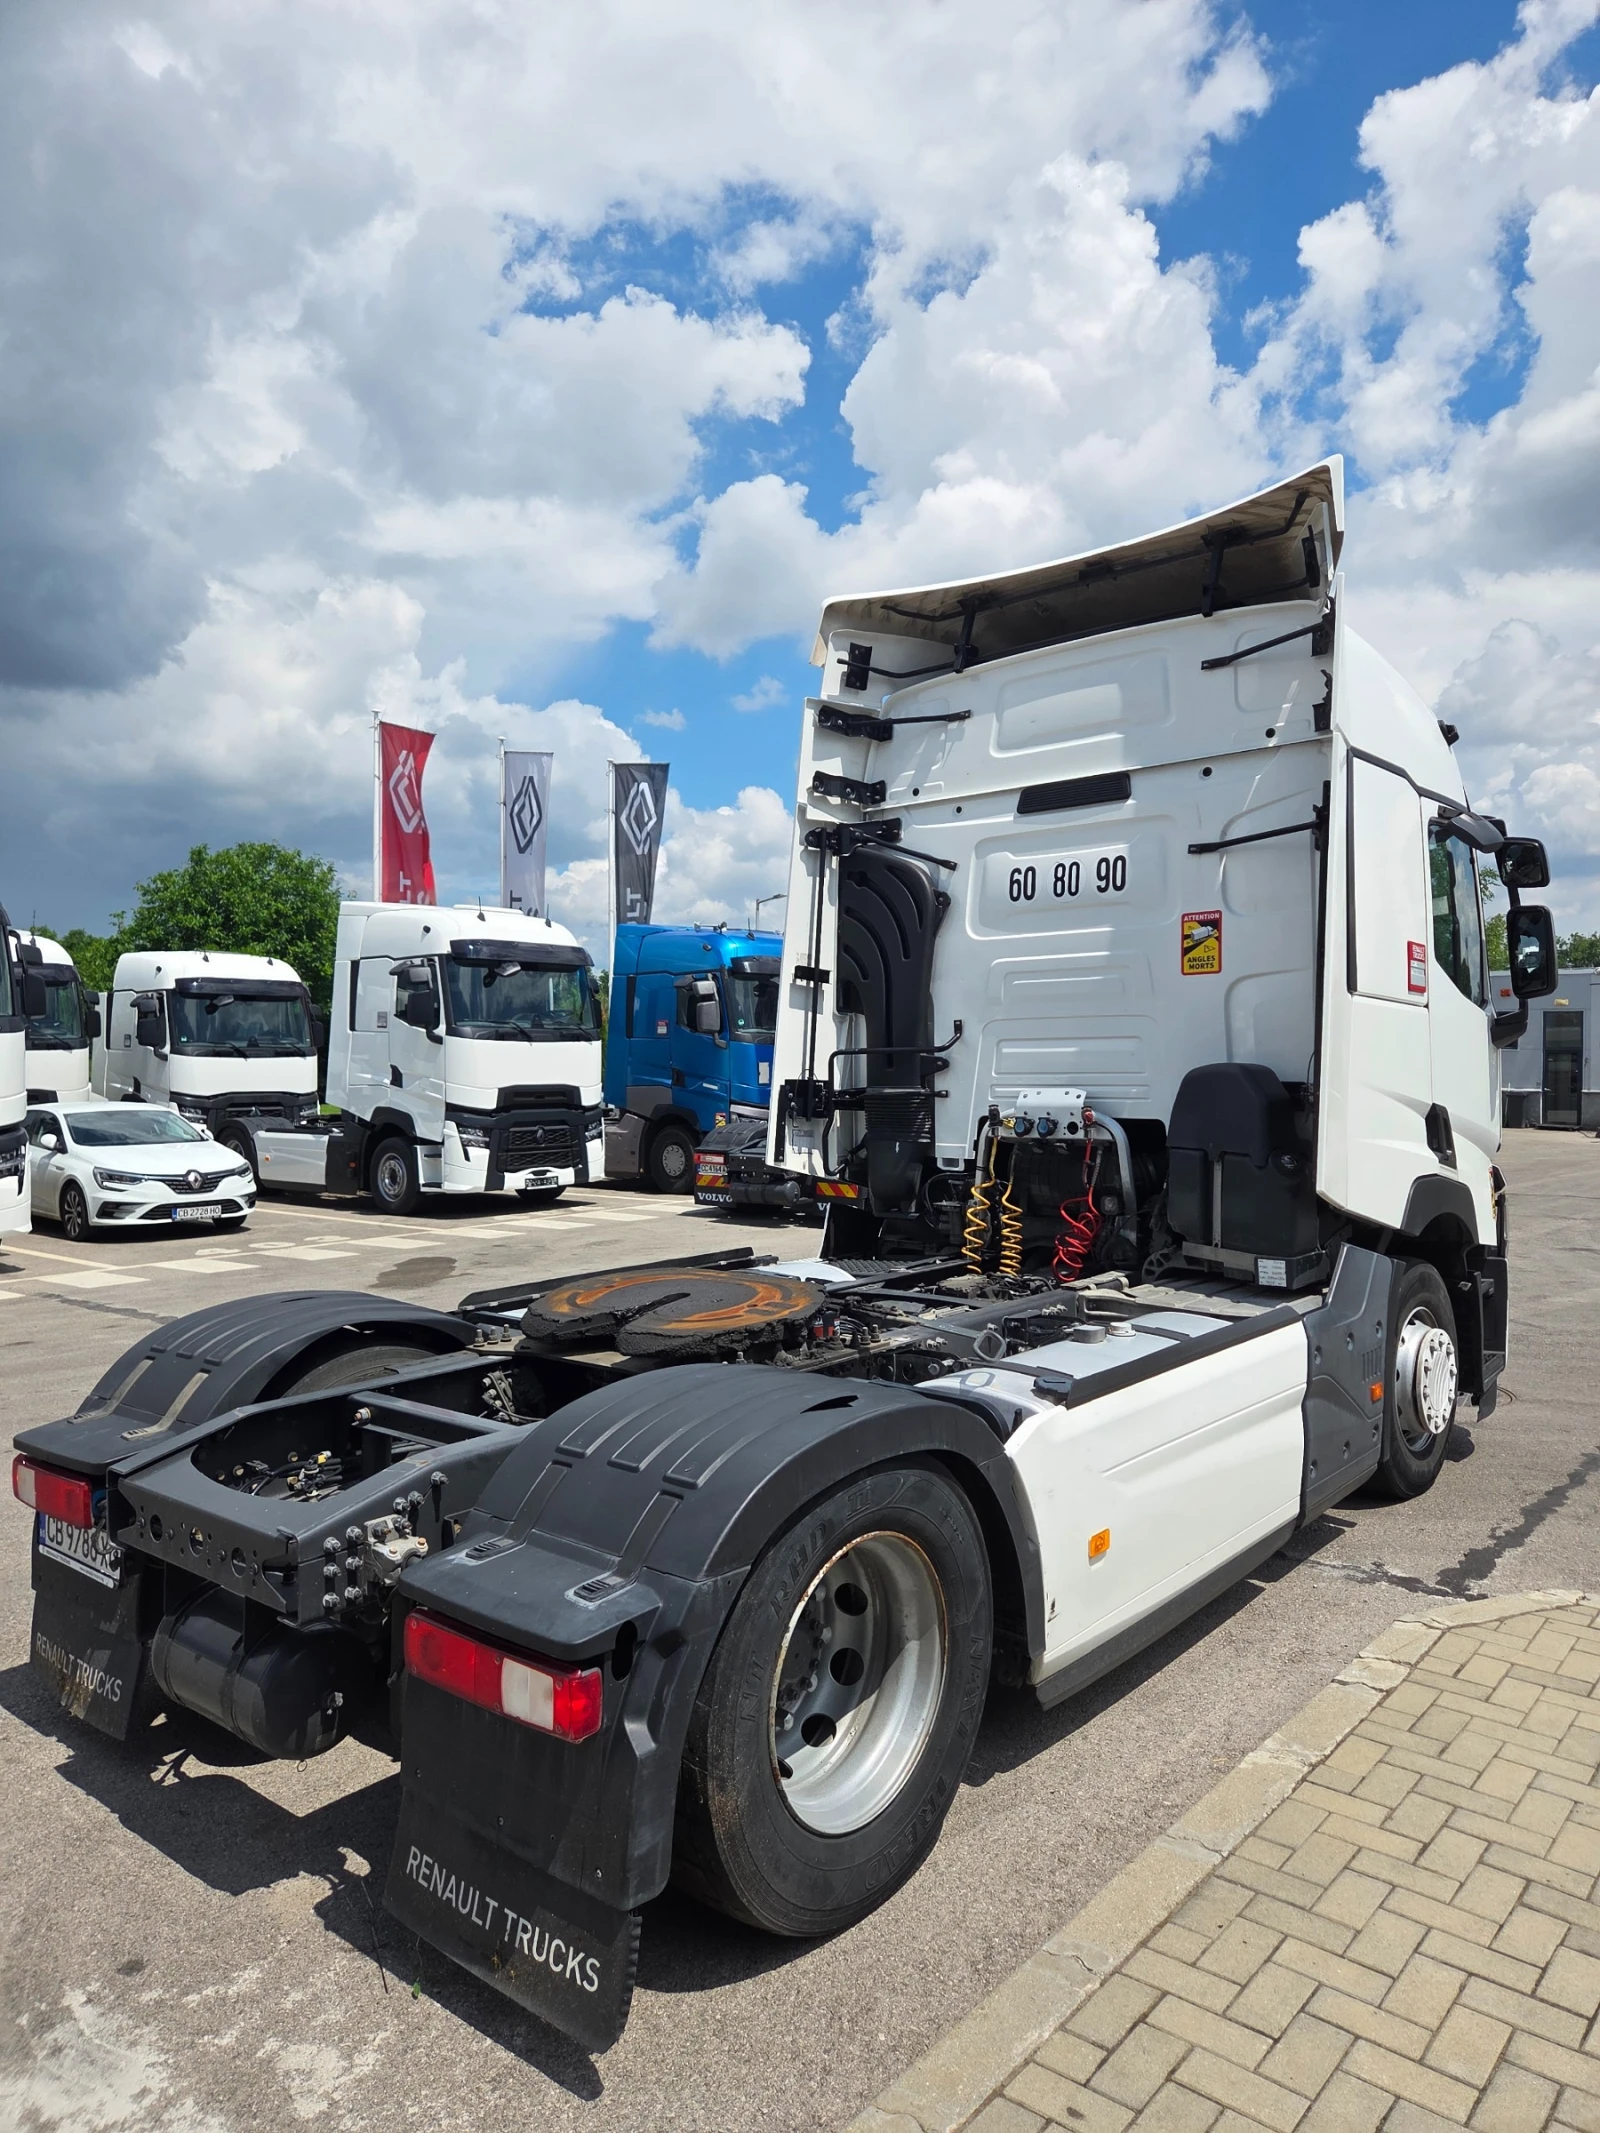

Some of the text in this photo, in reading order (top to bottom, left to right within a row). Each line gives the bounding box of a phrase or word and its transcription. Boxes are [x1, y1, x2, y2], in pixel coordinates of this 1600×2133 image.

[1009, 855, 1127, 902] 60 80 90
[1183, 912, 1220, 922] ATTENTION
[1187, 955, 1216, 964] ANGLES
[1188, 962, 1215, 970] MORTS
[697, 1192, 733, 1203] VOLVO
[47, 1515, 64, 1547] CB
[36, 1632, 122, 1702] RENAULT TRUCKS
[406, 1845, 601, 1993] RENAULT TRUCKS
